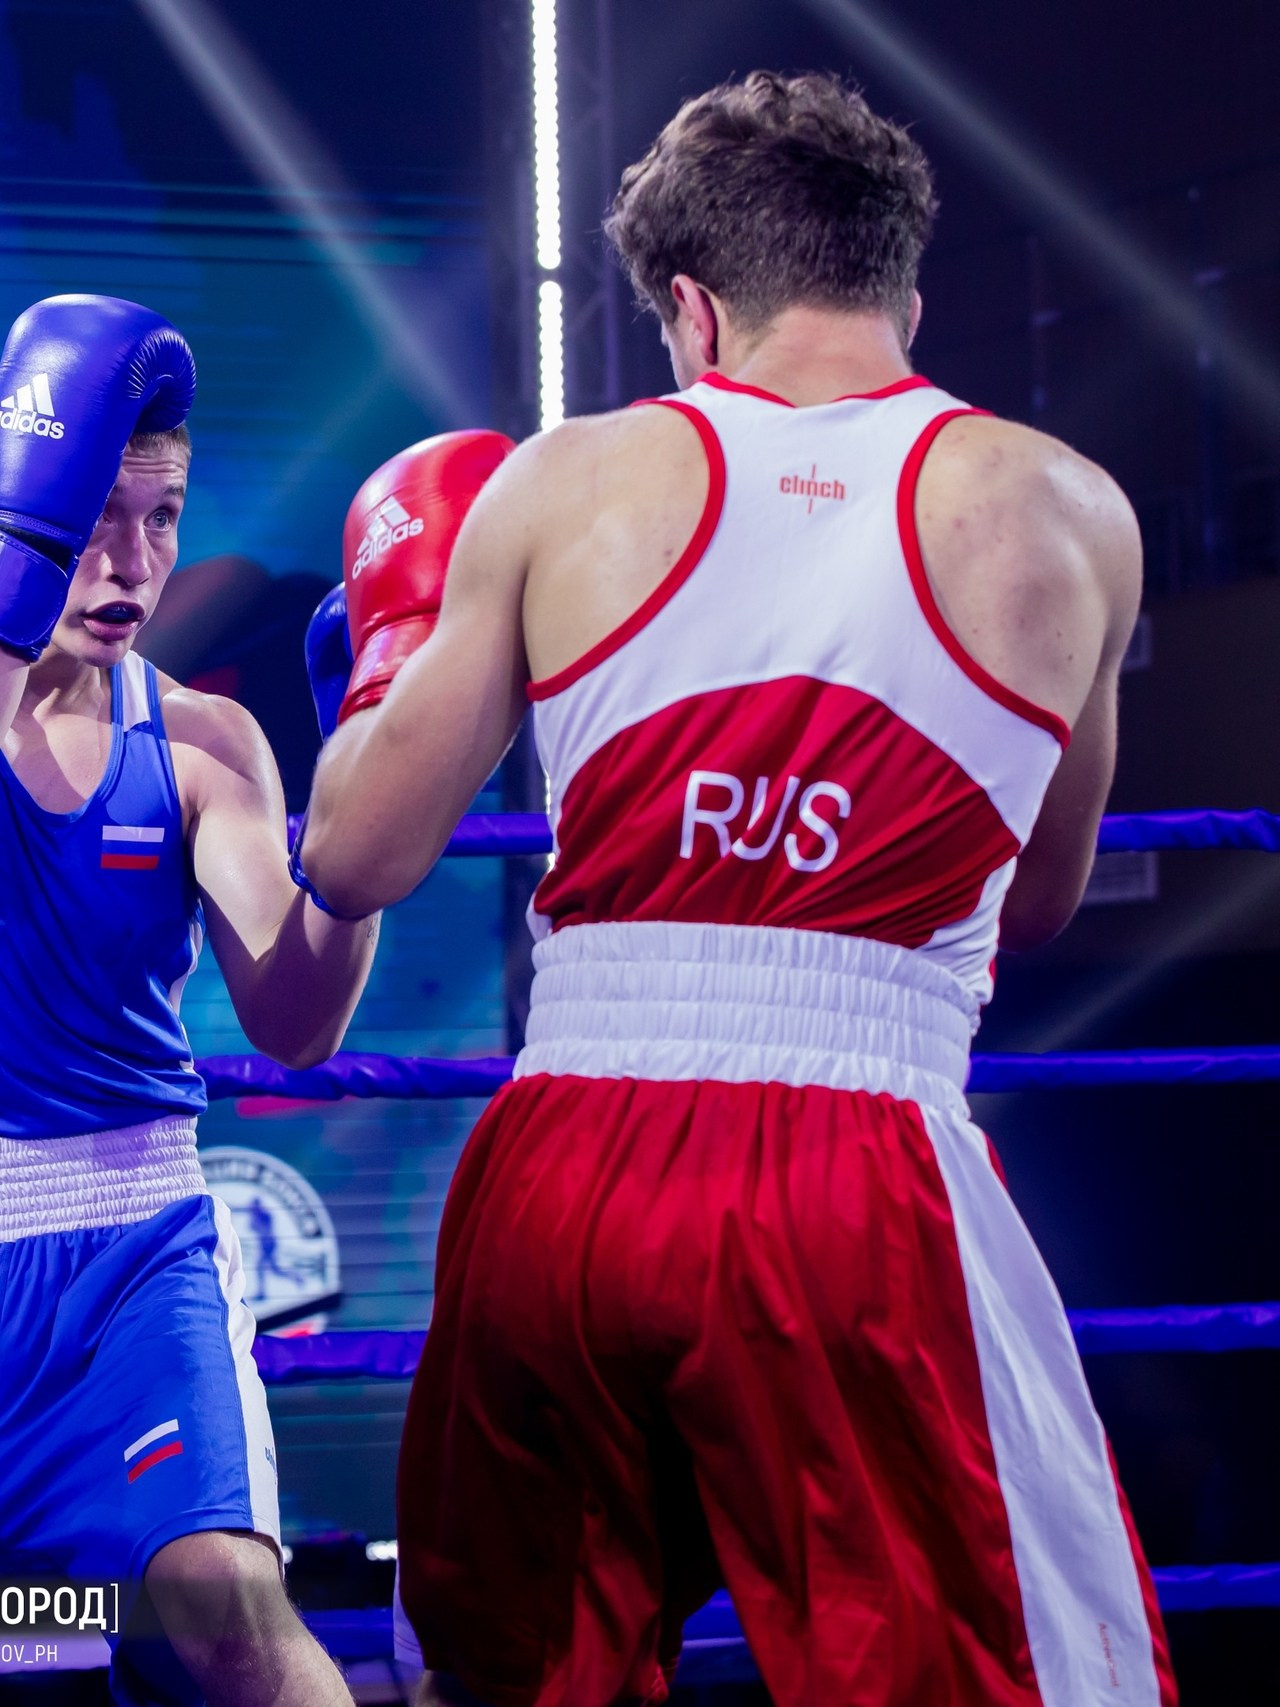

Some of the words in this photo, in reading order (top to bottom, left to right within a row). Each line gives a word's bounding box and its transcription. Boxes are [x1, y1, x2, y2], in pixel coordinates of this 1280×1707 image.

[779, 470, 846, 506] clinch
[351, 517, 425, 581] adidas
[679, 769, 852, 872] RUS
